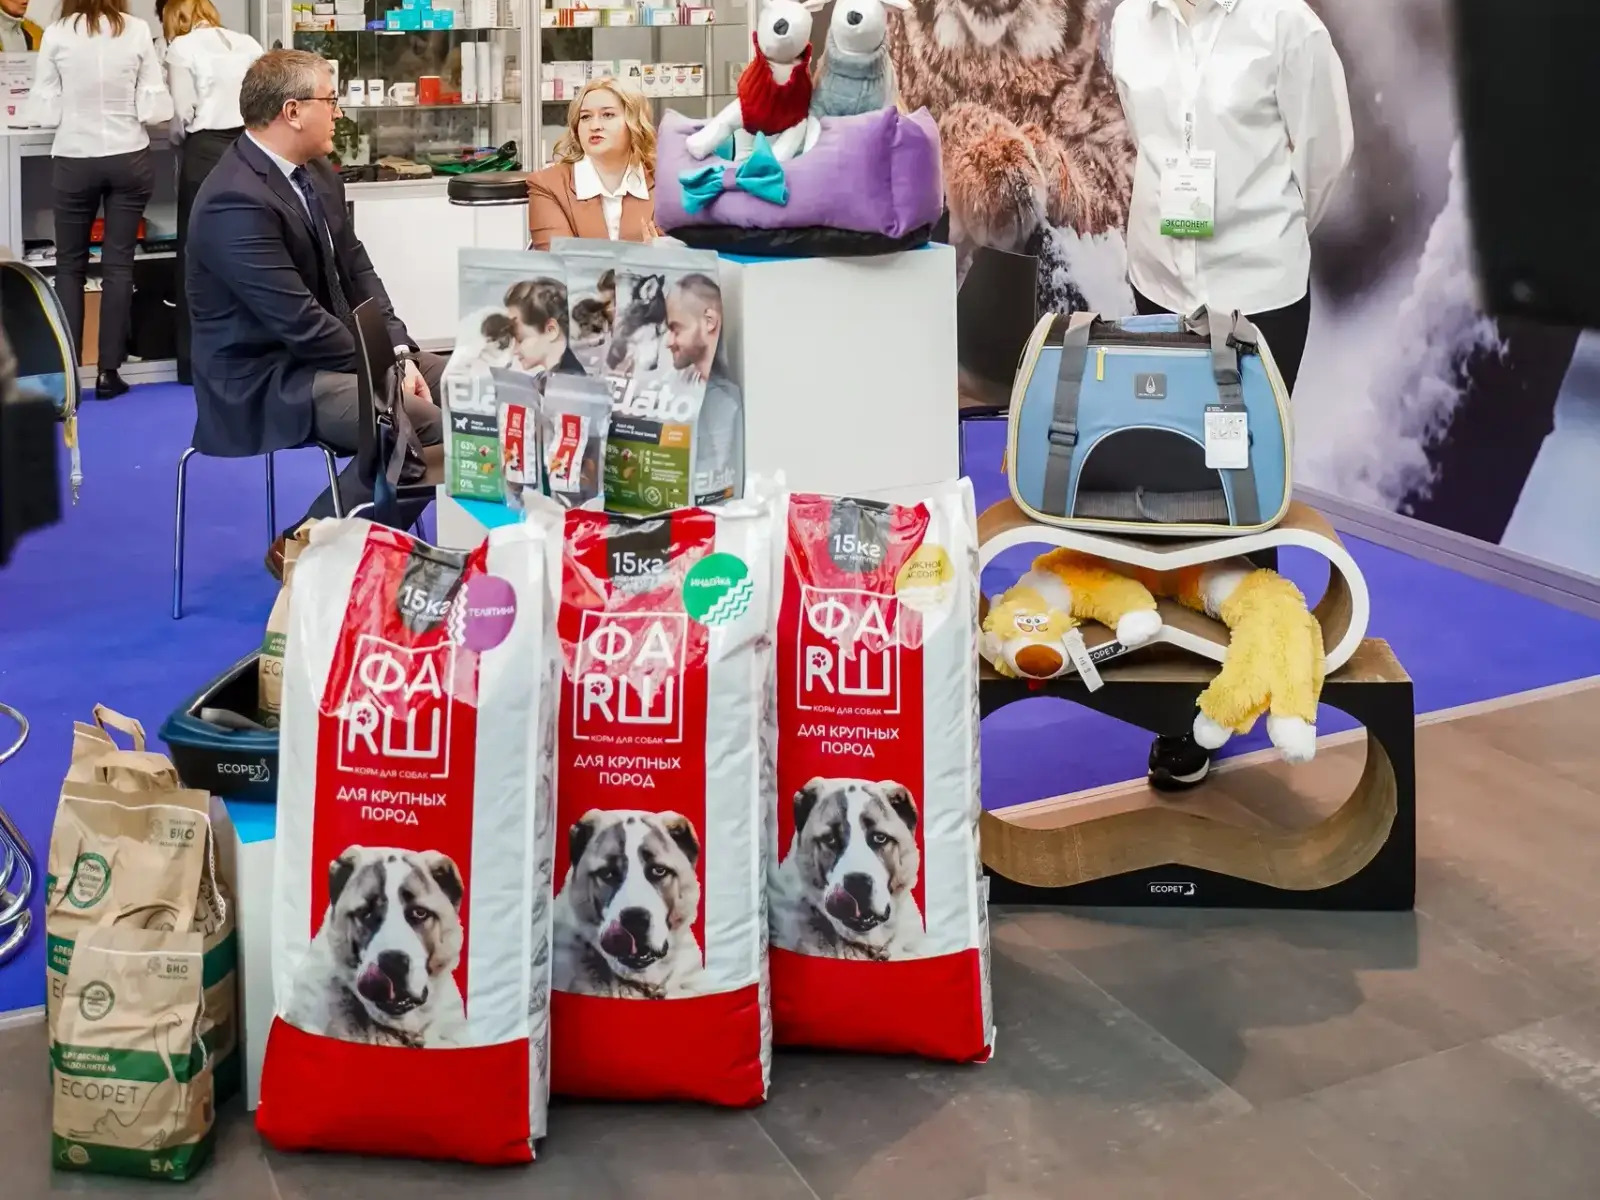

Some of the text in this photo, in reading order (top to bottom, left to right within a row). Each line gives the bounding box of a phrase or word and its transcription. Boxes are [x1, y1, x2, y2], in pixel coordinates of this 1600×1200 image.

[1165, 219, 1209, 228] ЭКСПОНЕНТ
[690, 576, 731, 587] ИНДЕЙКА
[468, 605, 515, 617] ТЕЛЯТИНА
[1089, 645, 1115, 661] COPET
[813, 705, 882, 715] КОРМ ДЛЯ СОБАК
[797, 723, 900, 740] ДЛЯ КРУПНЫХ
[591, 735, 664, 744] КОРМ ДЛЯ СОБАК
[821, 741, 876, 758] ПОРОД
[573, 753, 681, 770] ДЛЯ КРУПНЫХ
[217, 763, 262, 775] ECOPET
[354, 766, 429, 779] КОРМ ДЛЯ СОБАК
[599, 771, 656, 789] ПОРОД
[336, 785, 447, 807] ДЛЯ КРУПНЫХ
[361, 805, 419, 826] ПОРОД
[1150, 885, 1184, 893] ECOPET
[166, 963, 188, 974] БИО
[59, 1077, 140, 1105] ECOPET
